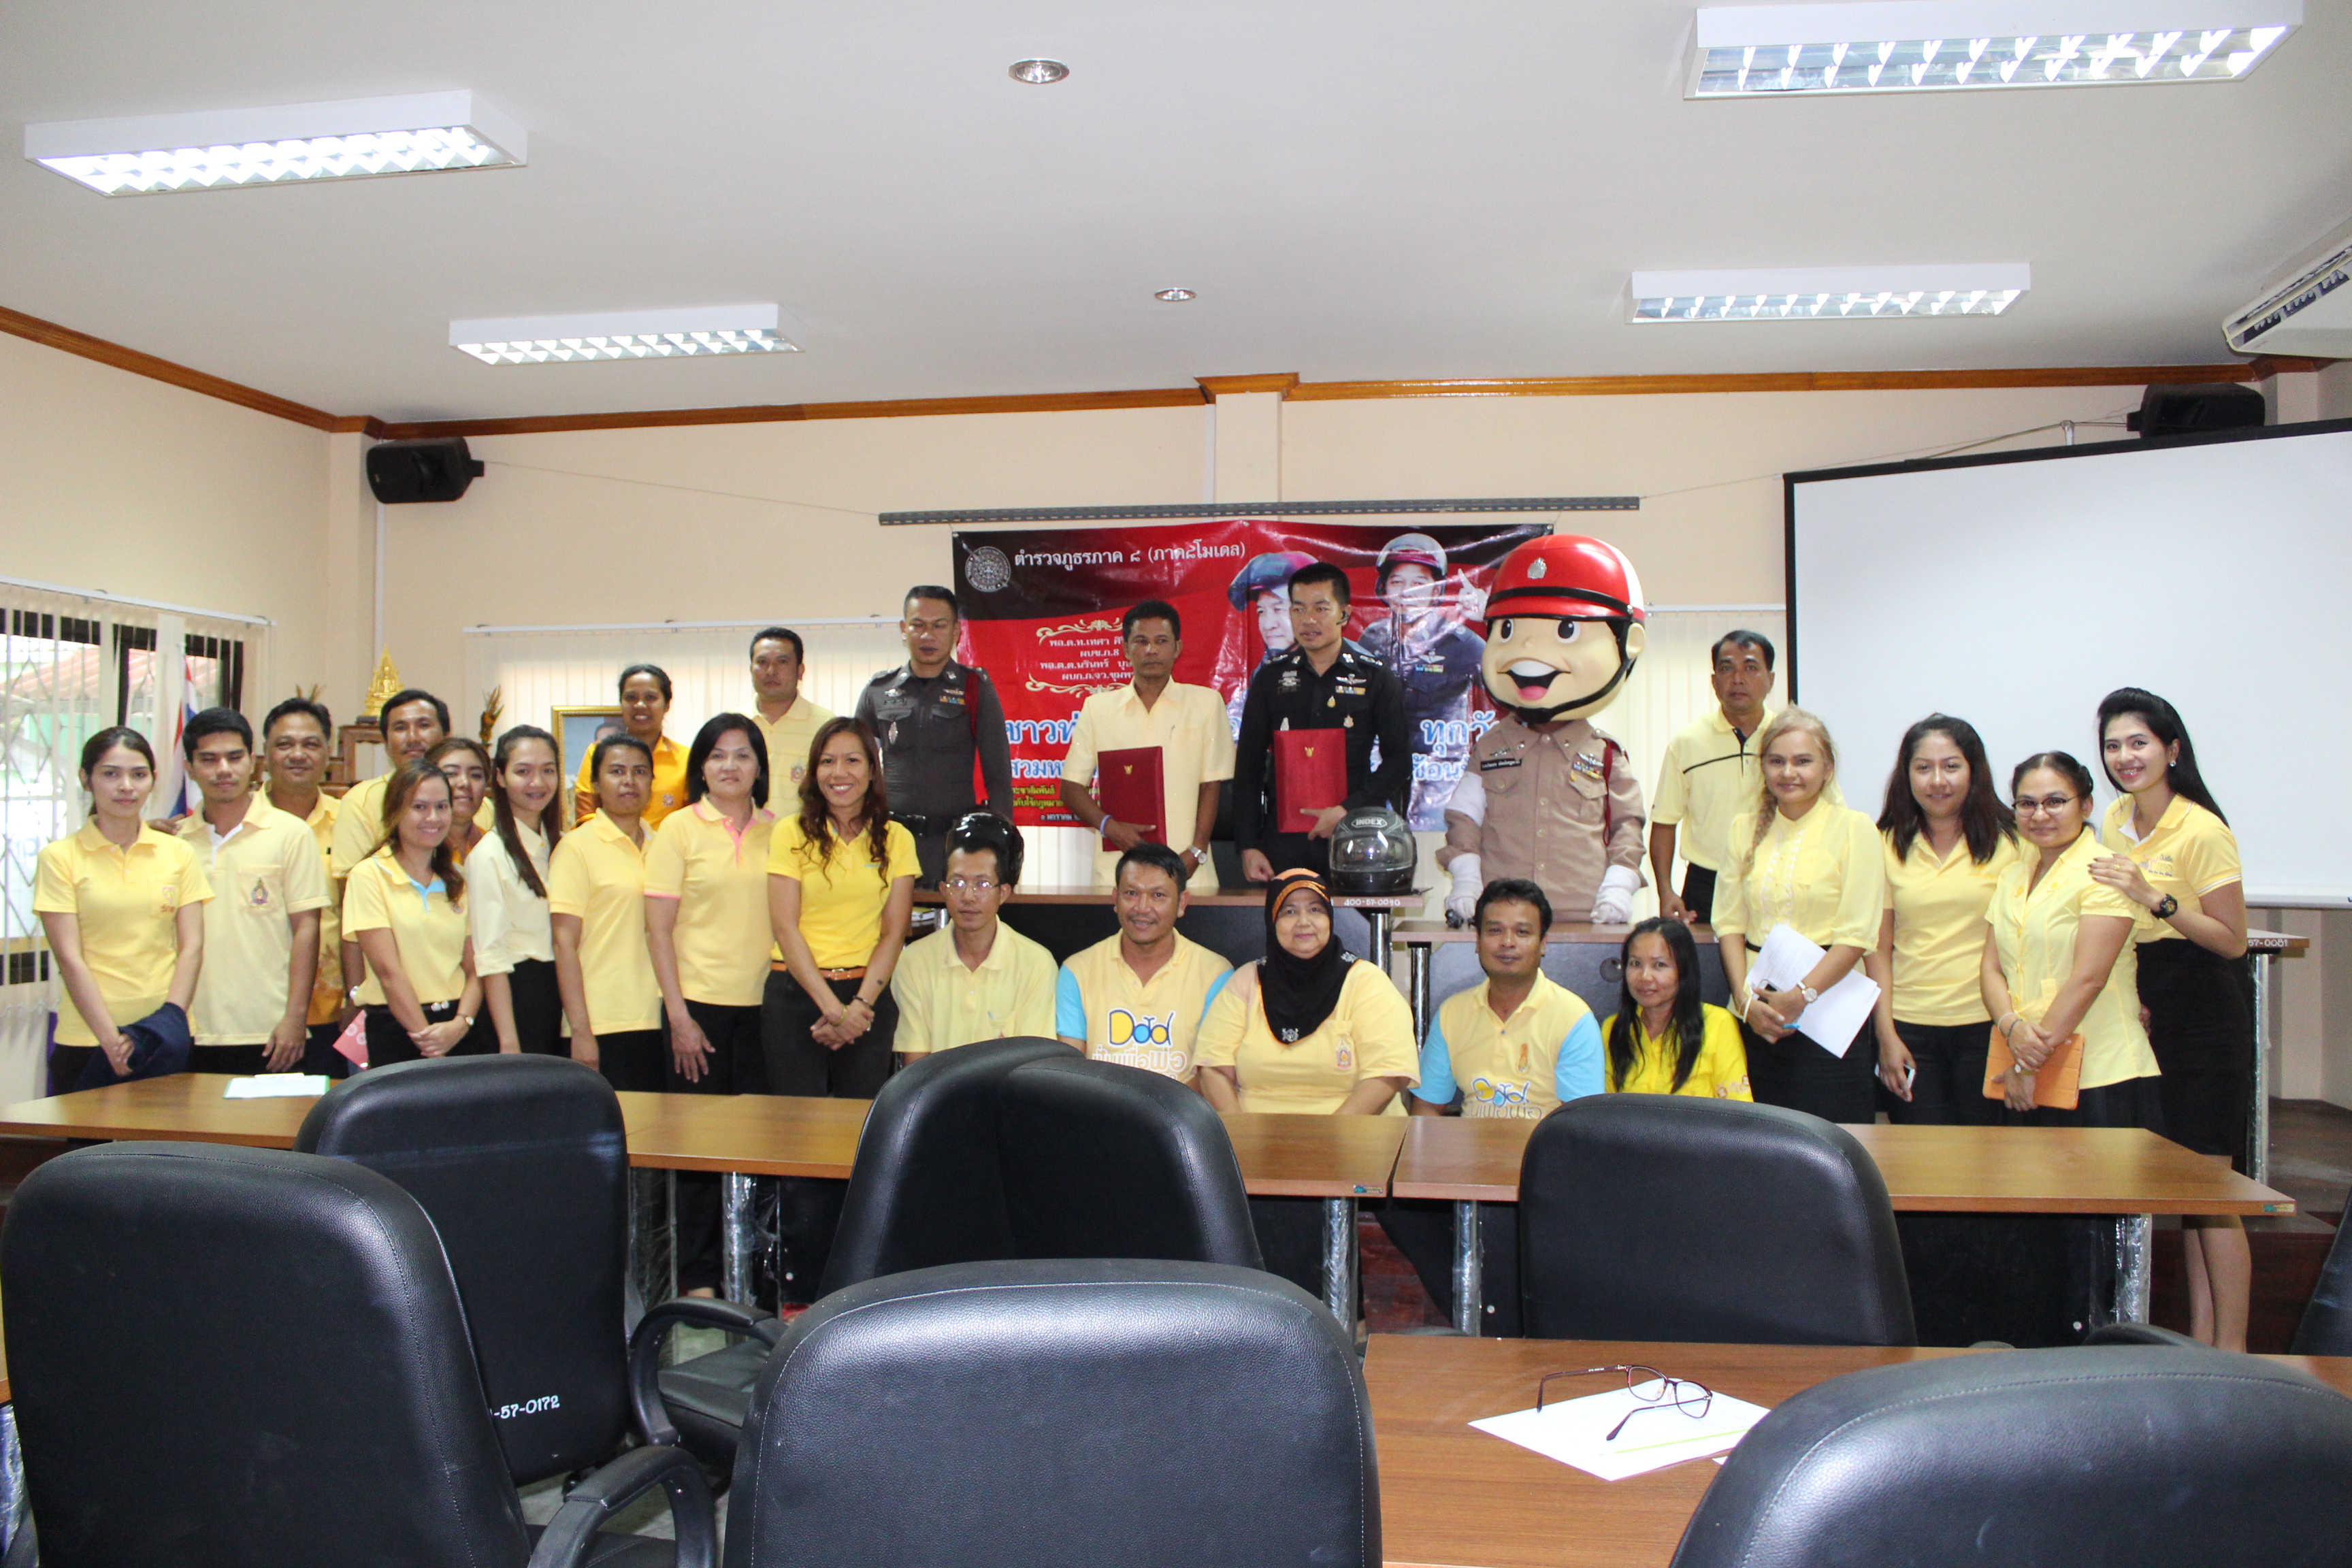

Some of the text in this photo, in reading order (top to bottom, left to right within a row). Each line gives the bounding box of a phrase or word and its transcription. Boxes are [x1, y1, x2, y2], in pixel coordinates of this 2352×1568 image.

[1015, 549, 1123, 571] ตำรวจภูธรภาค
[1356, 818, 1382, 826] INDEX
[490, 1394, 561, 1420] -57-0172
